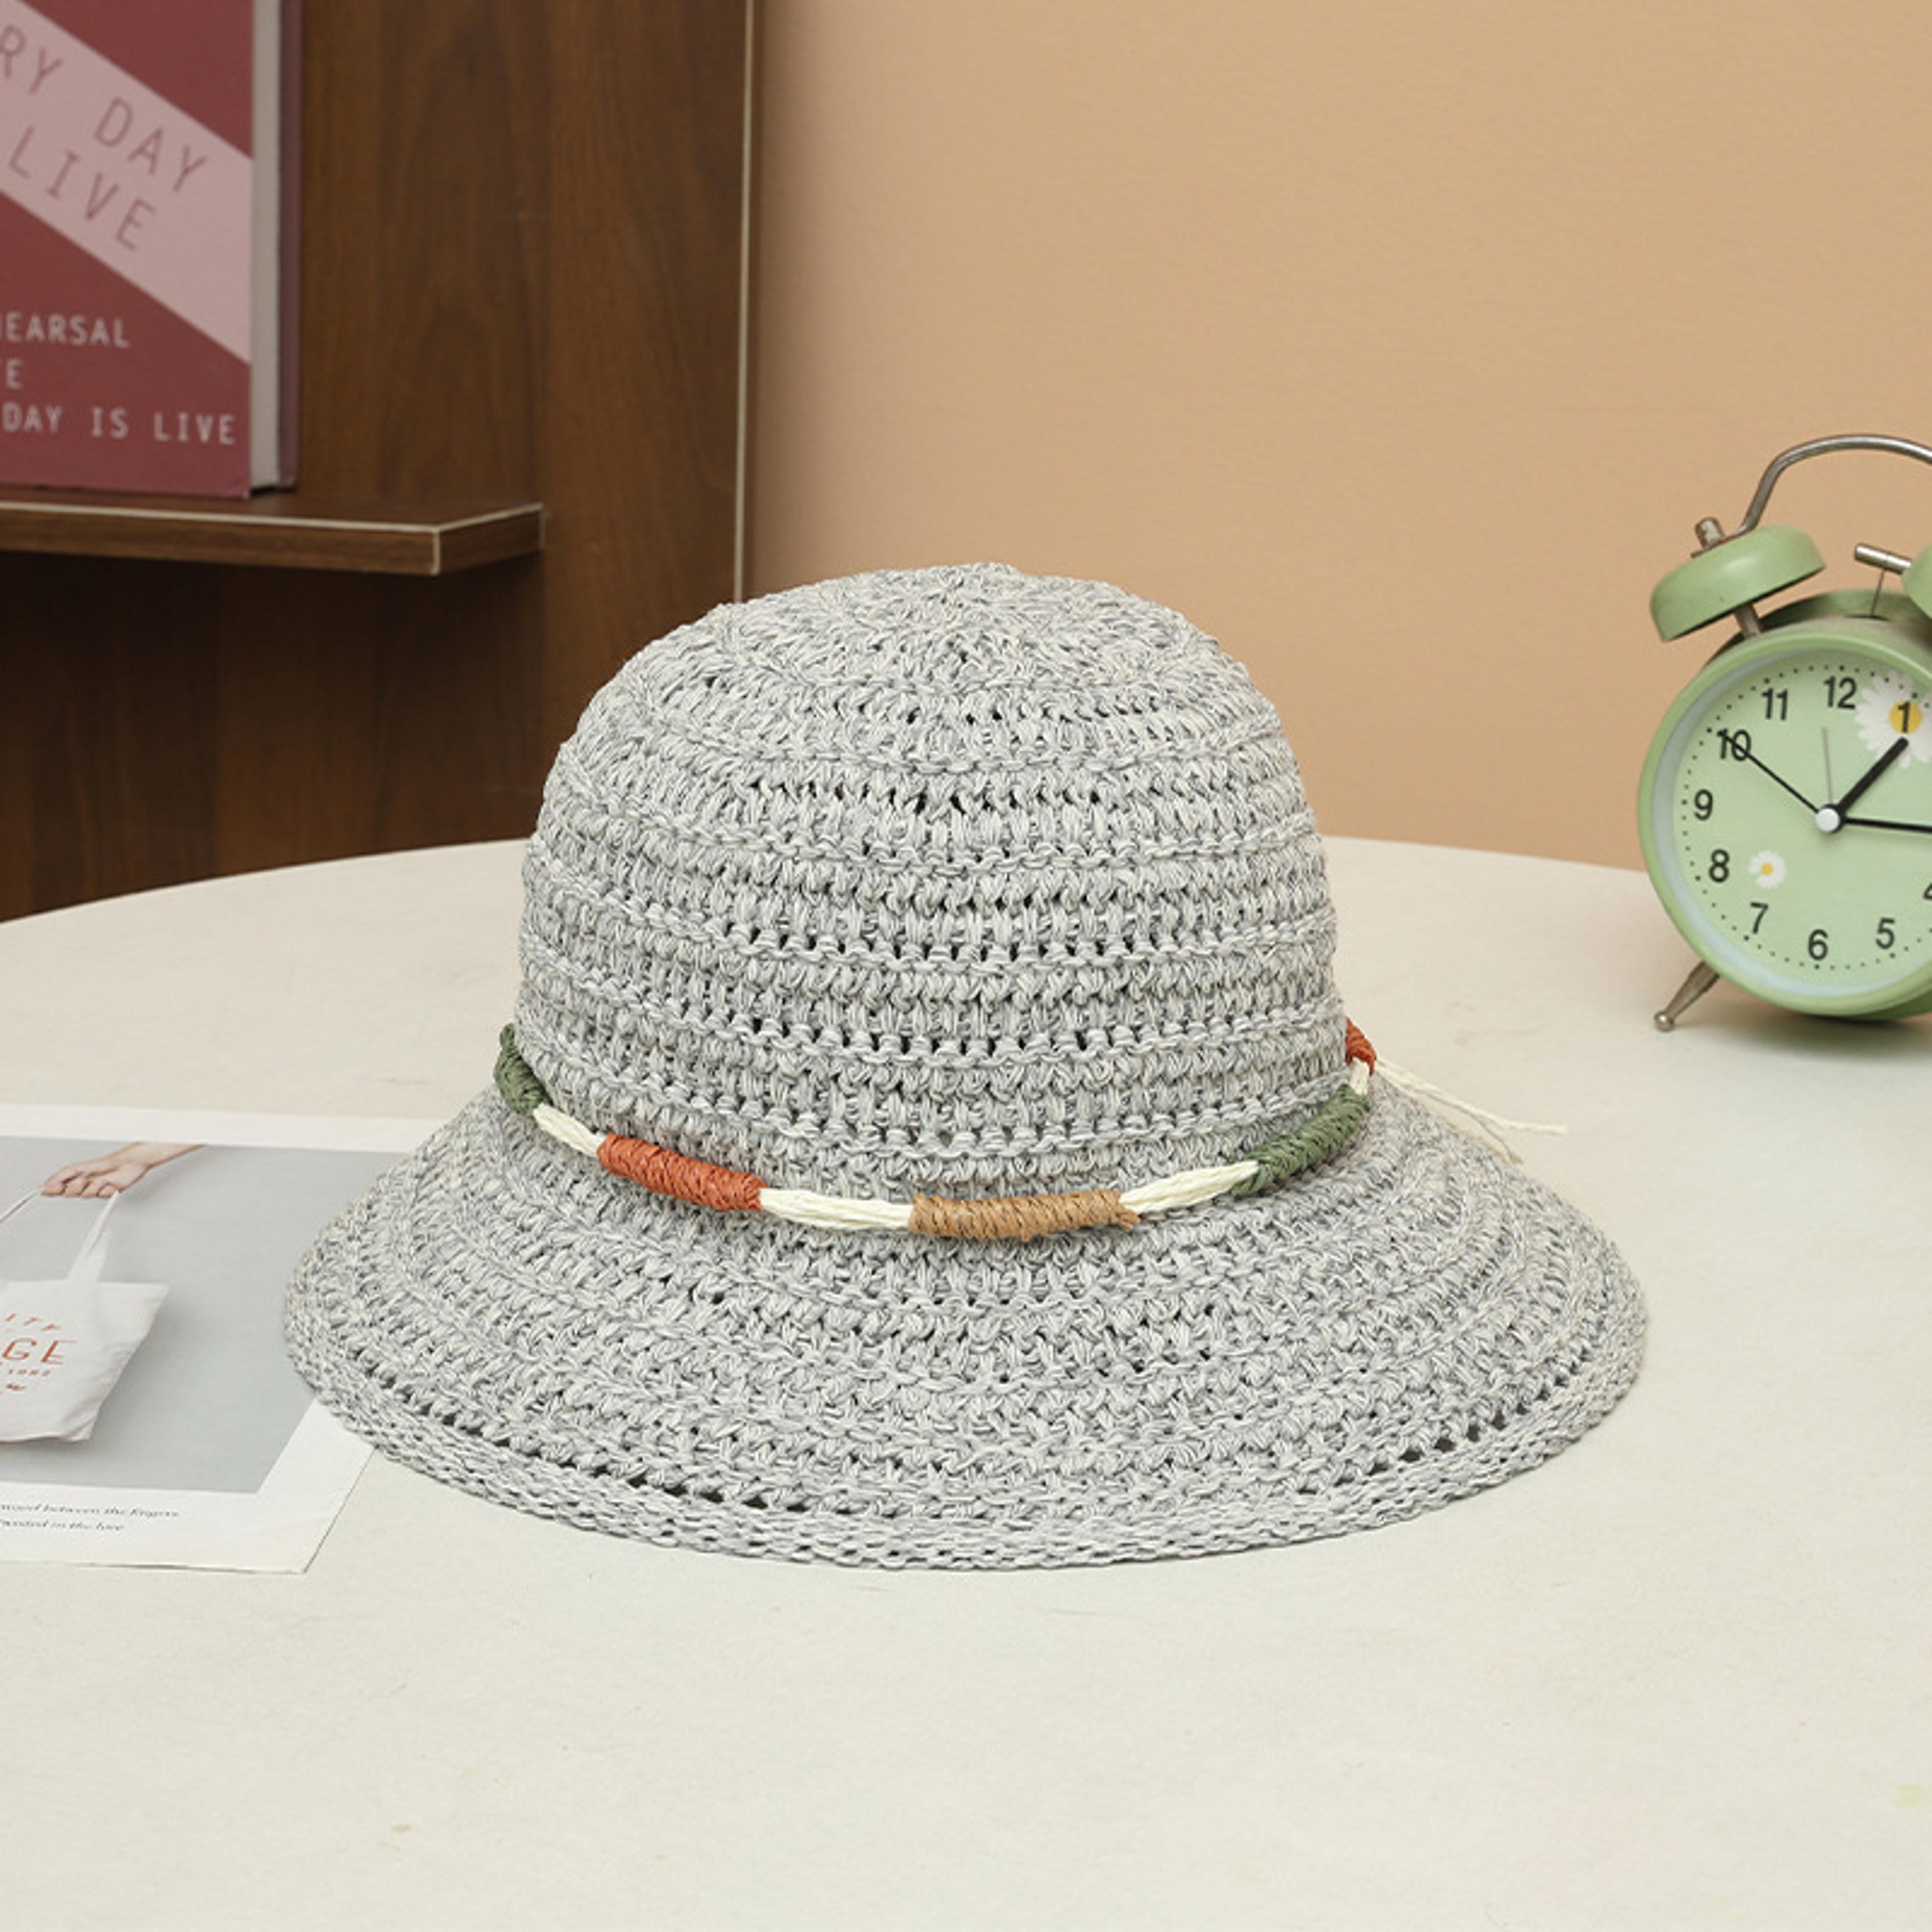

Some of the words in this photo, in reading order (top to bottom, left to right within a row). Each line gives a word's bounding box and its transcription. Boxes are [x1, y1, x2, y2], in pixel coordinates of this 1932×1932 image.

[95, 97, 208, 192] DAY
[9, 125, 156, 251] LIVE
[2, 401, 63, 433] DAY
[91, 407, 129, 439] IS
[153, 412, 235, 445] LIVE
[1761, 688, 1789, 721] 11
[1823, 676, 1857, 709] 12
[1898, 701, 1912, 733] 1
[1717, 729, 1751, 762] 10
[1694, 789, 1714, 821] 9
[1708, 849, 1730, 882] 8
[1750, 902, 1768, 934] 7
[1875, 918, 1896, 949] 5
[1808, 929, 1829, 961] 6
